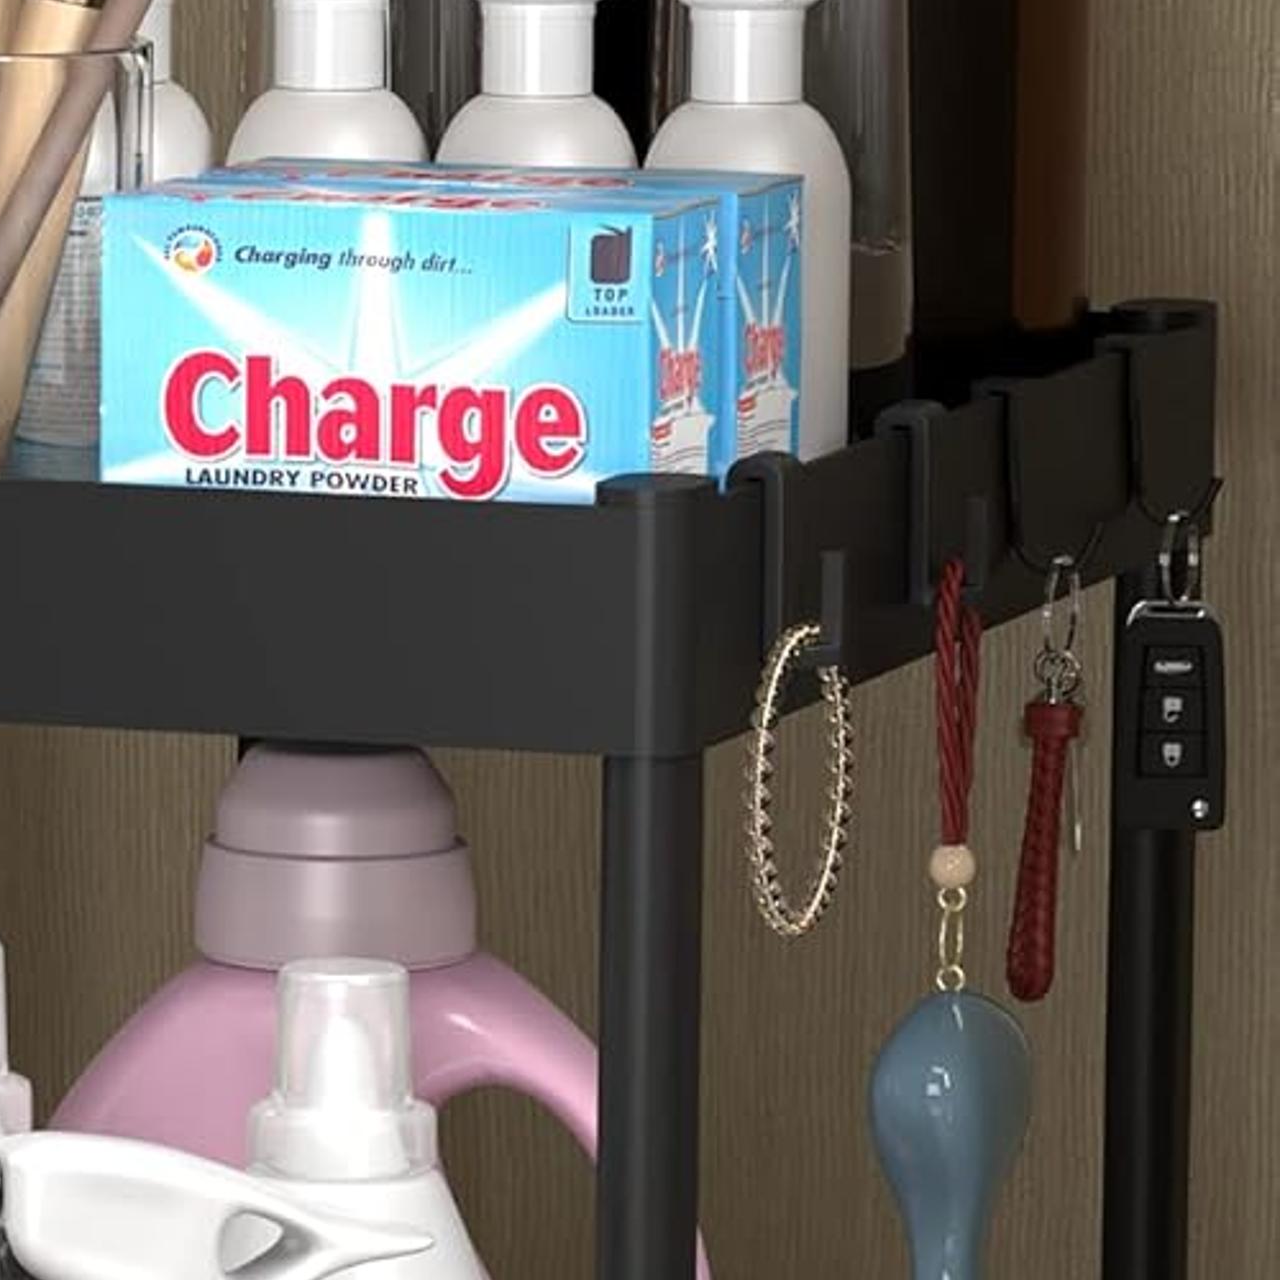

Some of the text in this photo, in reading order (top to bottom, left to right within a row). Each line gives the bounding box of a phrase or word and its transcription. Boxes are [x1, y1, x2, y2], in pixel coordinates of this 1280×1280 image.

[234, 245, 332, 270] Charging
[338, 247, 416, 272] through
[594, 288, 629, 303] TOP
[163, 349, 584, 498] Charge
[185, 467, 419, 494] LAUNDRY POWDER
